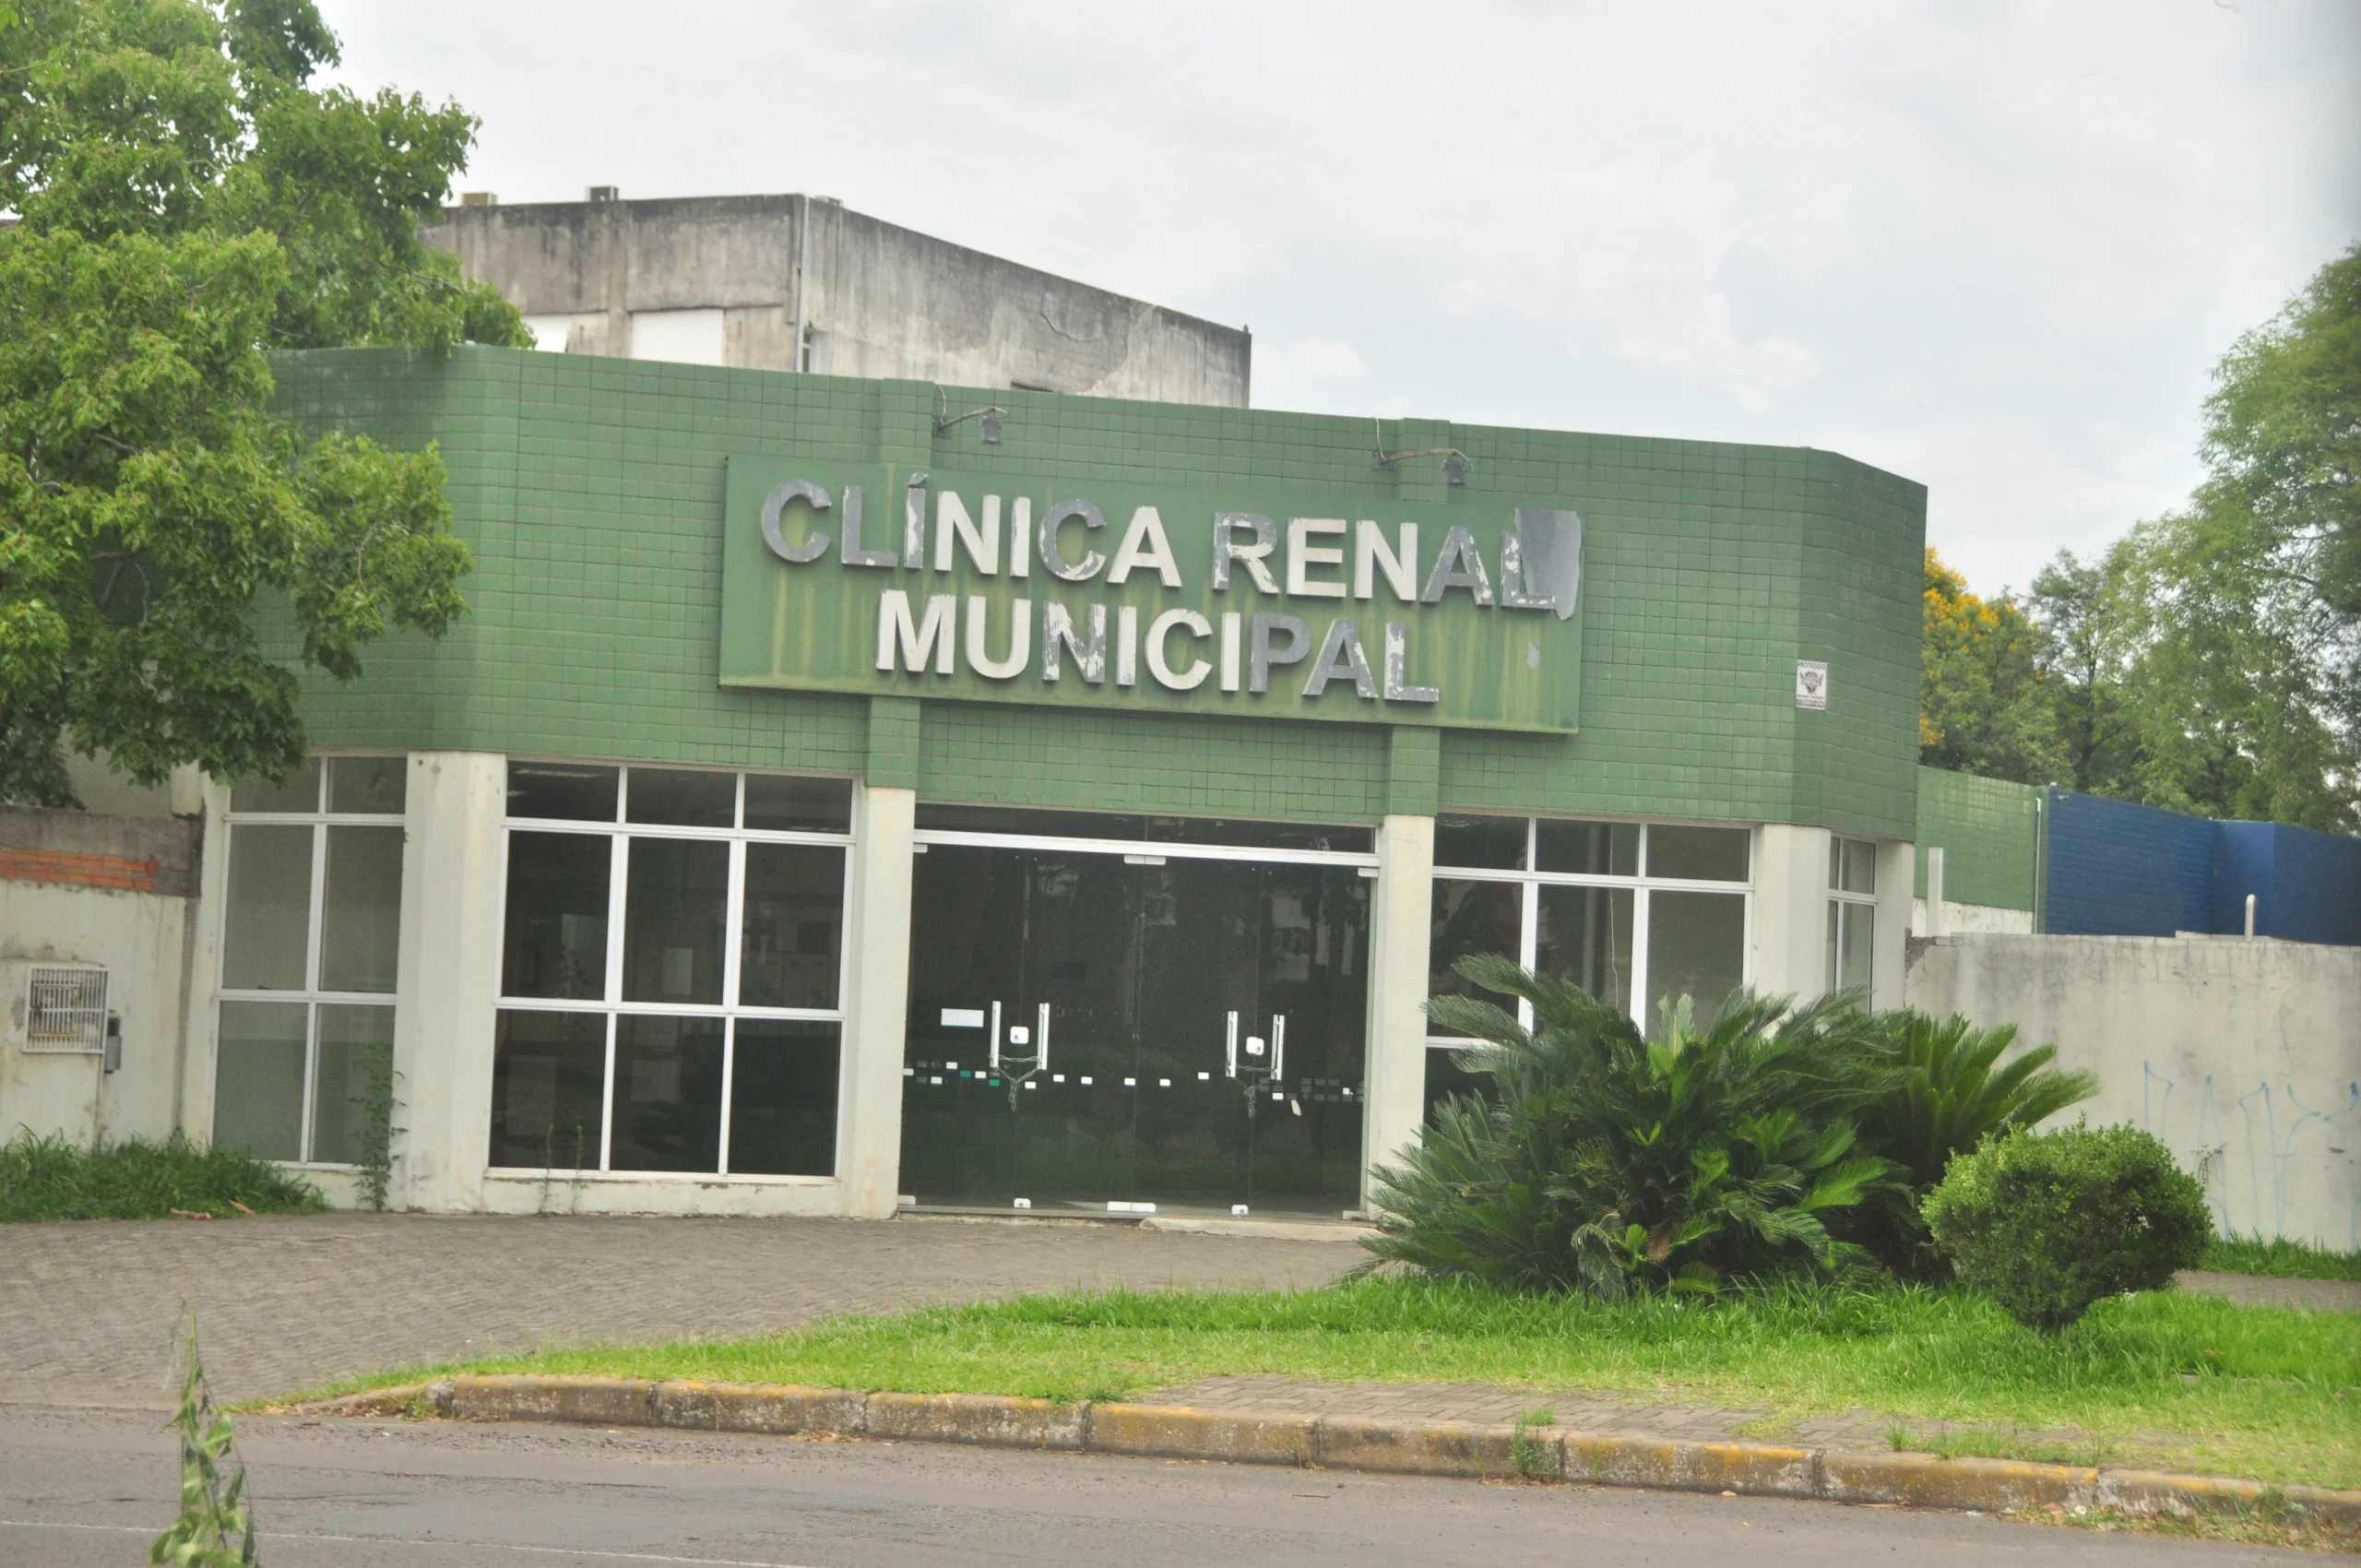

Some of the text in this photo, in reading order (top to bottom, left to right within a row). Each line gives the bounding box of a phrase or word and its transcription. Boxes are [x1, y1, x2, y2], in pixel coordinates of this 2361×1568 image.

[760, 471, 1556, 611] CLÍNICA RENAL
[875, 588, 1440, 703] MUNICIPAL
[1797, 661, 1826, 671] PROTEGIDO
